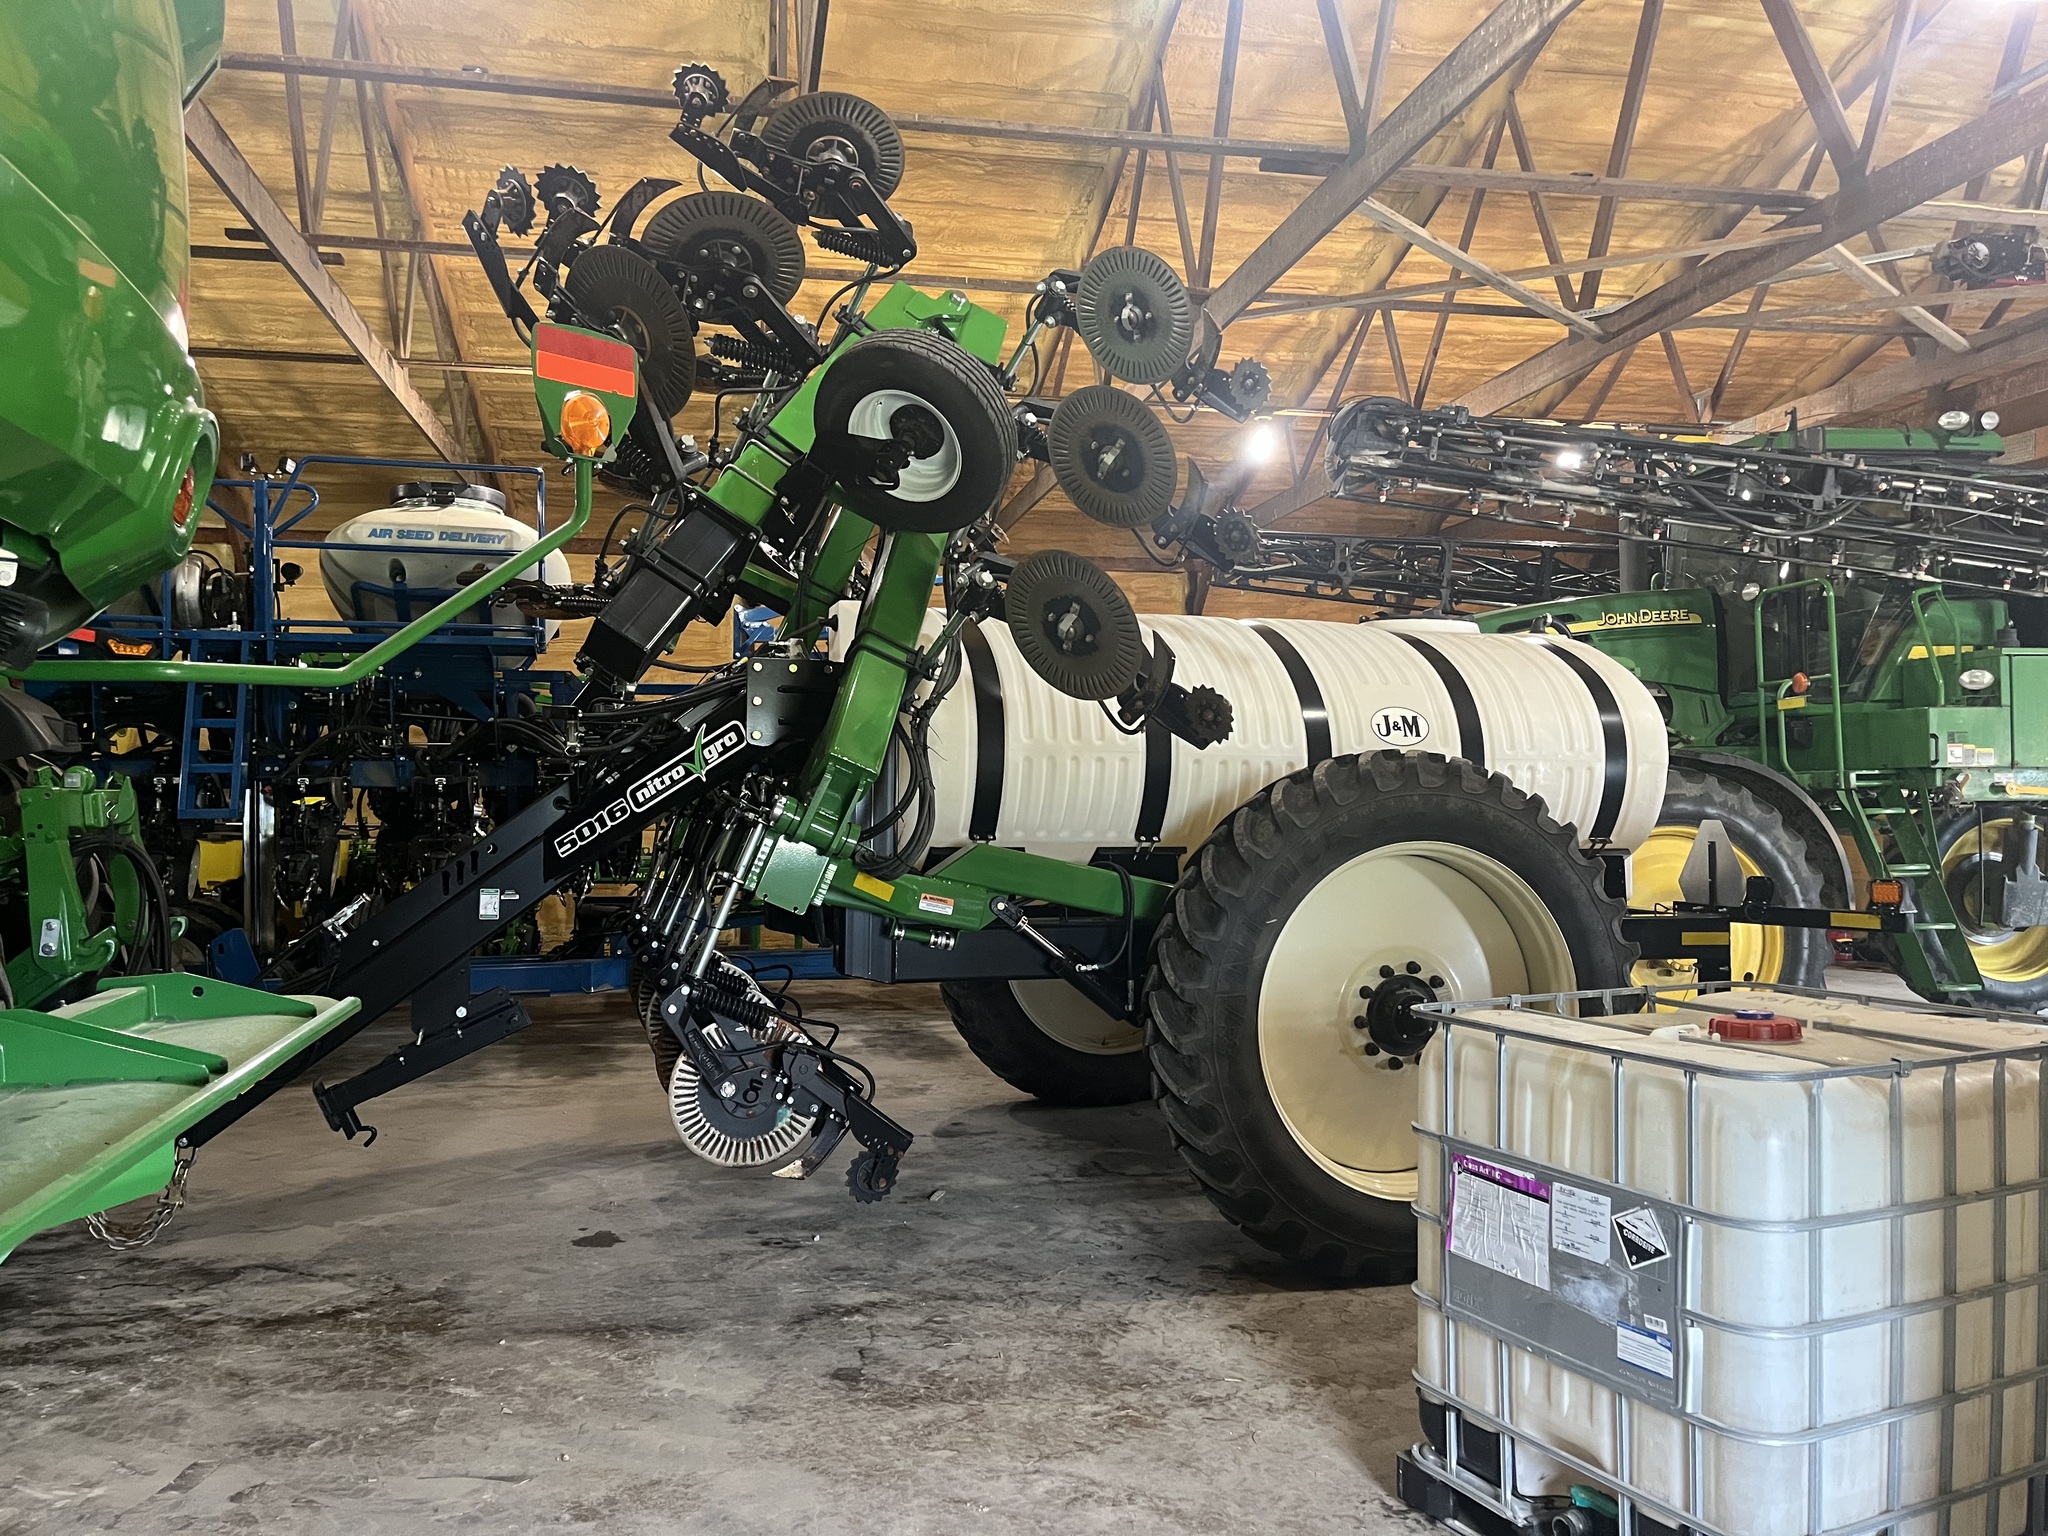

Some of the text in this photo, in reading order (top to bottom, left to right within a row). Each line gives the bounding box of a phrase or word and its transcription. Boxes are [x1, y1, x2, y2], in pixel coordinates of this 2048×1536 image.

[367, 528, 506, 545] AIR SEED DELIVERY
[1597, 609, 1690, 626] JOHN DEERE
[1376, 714, 1422, 738] J&M
[554, 797, 631, 858] 5016
[635, 765, 686, 804] nitro
[702, 731, 738, 764] gro
[1623, 1228, 1656, 1255] CORROSIVE
